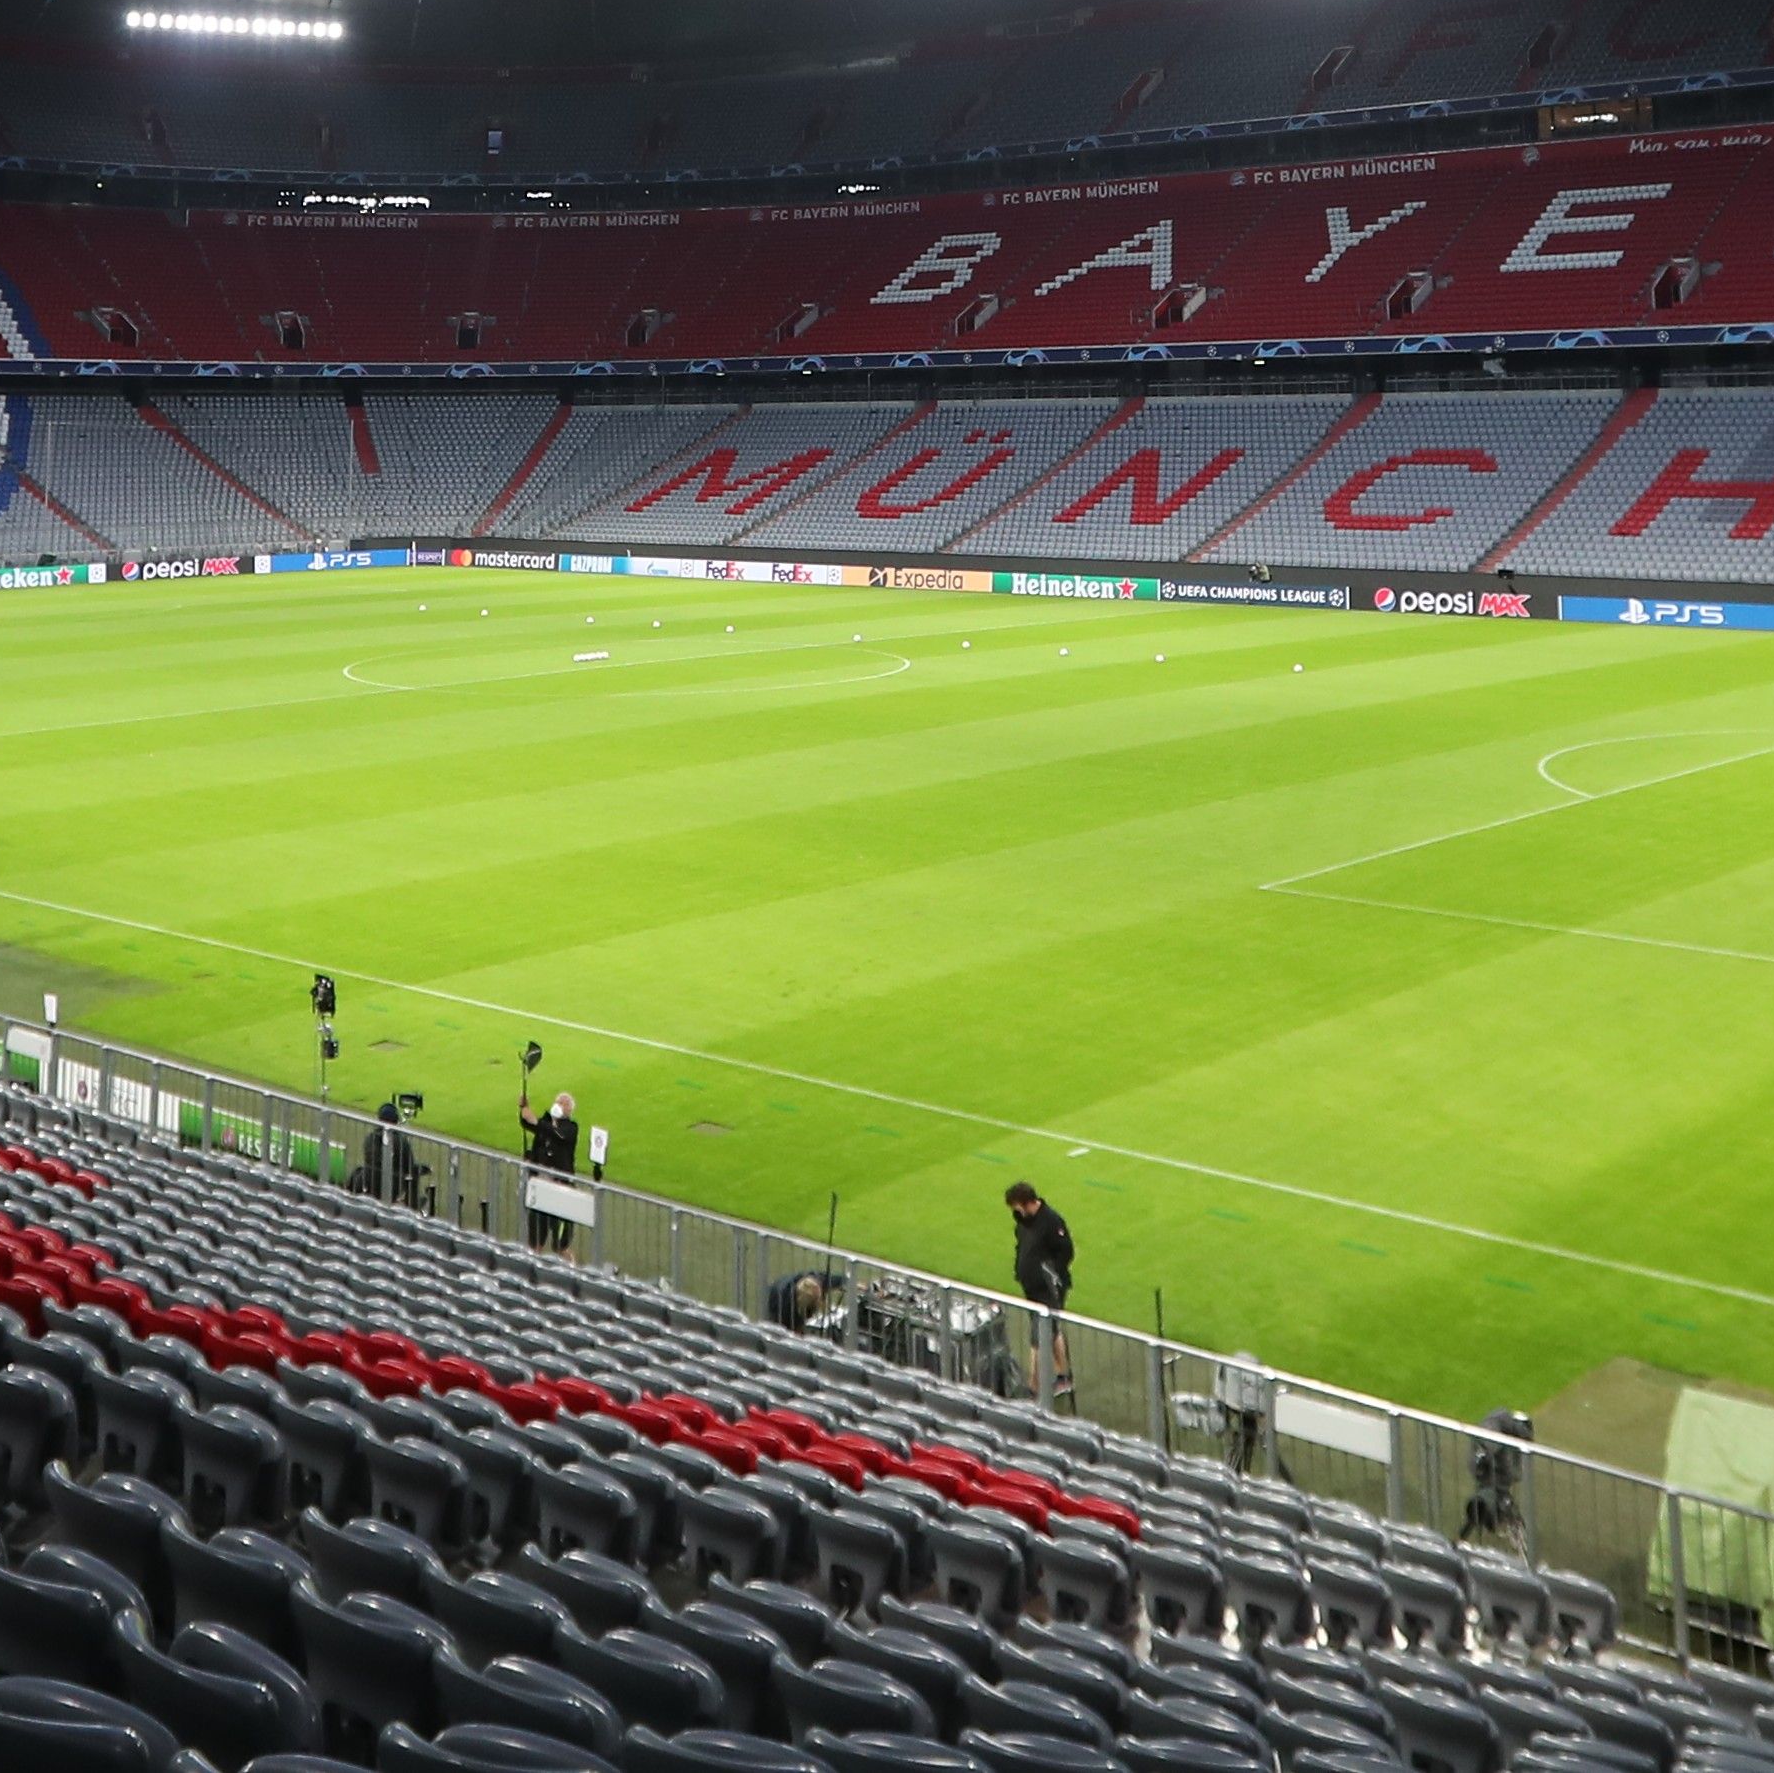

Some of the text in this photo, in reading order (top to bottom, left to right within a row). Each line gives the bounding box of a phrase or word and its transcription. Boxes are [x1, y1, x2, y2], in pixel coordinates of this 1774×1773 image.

[1253, 157, 1436, 185] FC BAYERN MÜNCHEN
[1002, 181, 1159, 206] FC BAYERN MÜNCHEN
[247, 215, 267, 227] FC
[272, 215, 335, 228] BAYERN
[514, 216, 534, 228] FC
[539, 215, 600, 229] BAYERN
[770, 202, 920, 222] FC BAYERN MÜNCHEN
[143, 557, 240, 580] pepsi MAX
[330, 552, 371, 567] PS5
[475, 551, 555, 570] mastercard
[571, 555, 613, 573] GAZPROM
[706, 561, 744, 581] FedEx
[772, 563, 812, 583] FedEx
[894, 567, 964, 590] Expedia
[1011, 573, 1115, 599] Heineken
[1178, 584, 1326, 604] UEFA CHAMPIONS LEAGUE
[1400, 591, 1531, 617] pepsi MAX
[1655, 603, 1725, 625] PS5
